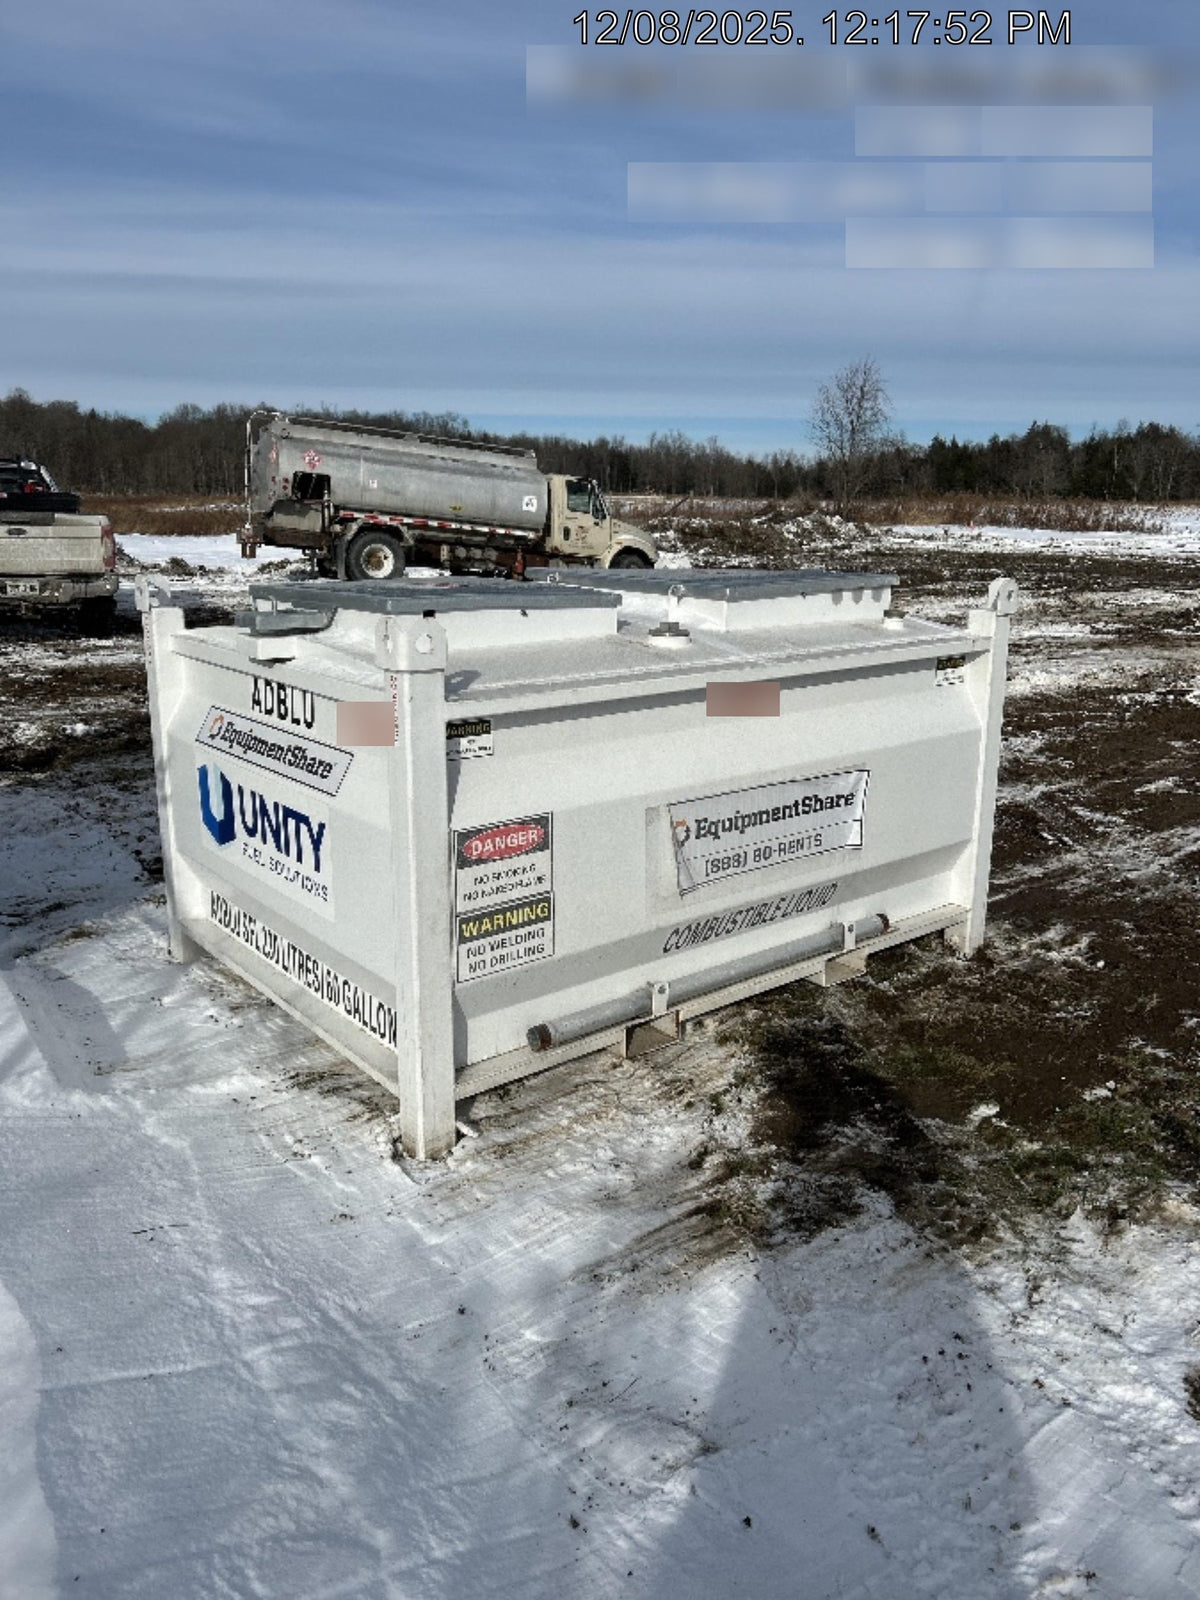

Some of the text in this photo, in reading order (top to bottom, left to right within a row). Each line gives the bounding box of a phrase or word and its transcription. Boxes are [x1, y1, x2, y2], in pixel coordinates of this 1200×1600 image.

[251, 675, 316, 730] ADBLU
[220, 721, 333, 779] EquipmentShare
[238, 784, 326, 873] UNITY
[694, 791, 856, 840] EquipmentShare
[472, 829, 538, 856] DANGER
[461, 902, 549, 938] WARNING
[466, 927, 545, 959] NO WELDING
[662, 897, 787, 954] COMBUSTIBLE
[489, 943, 545, 969] DRILLING
